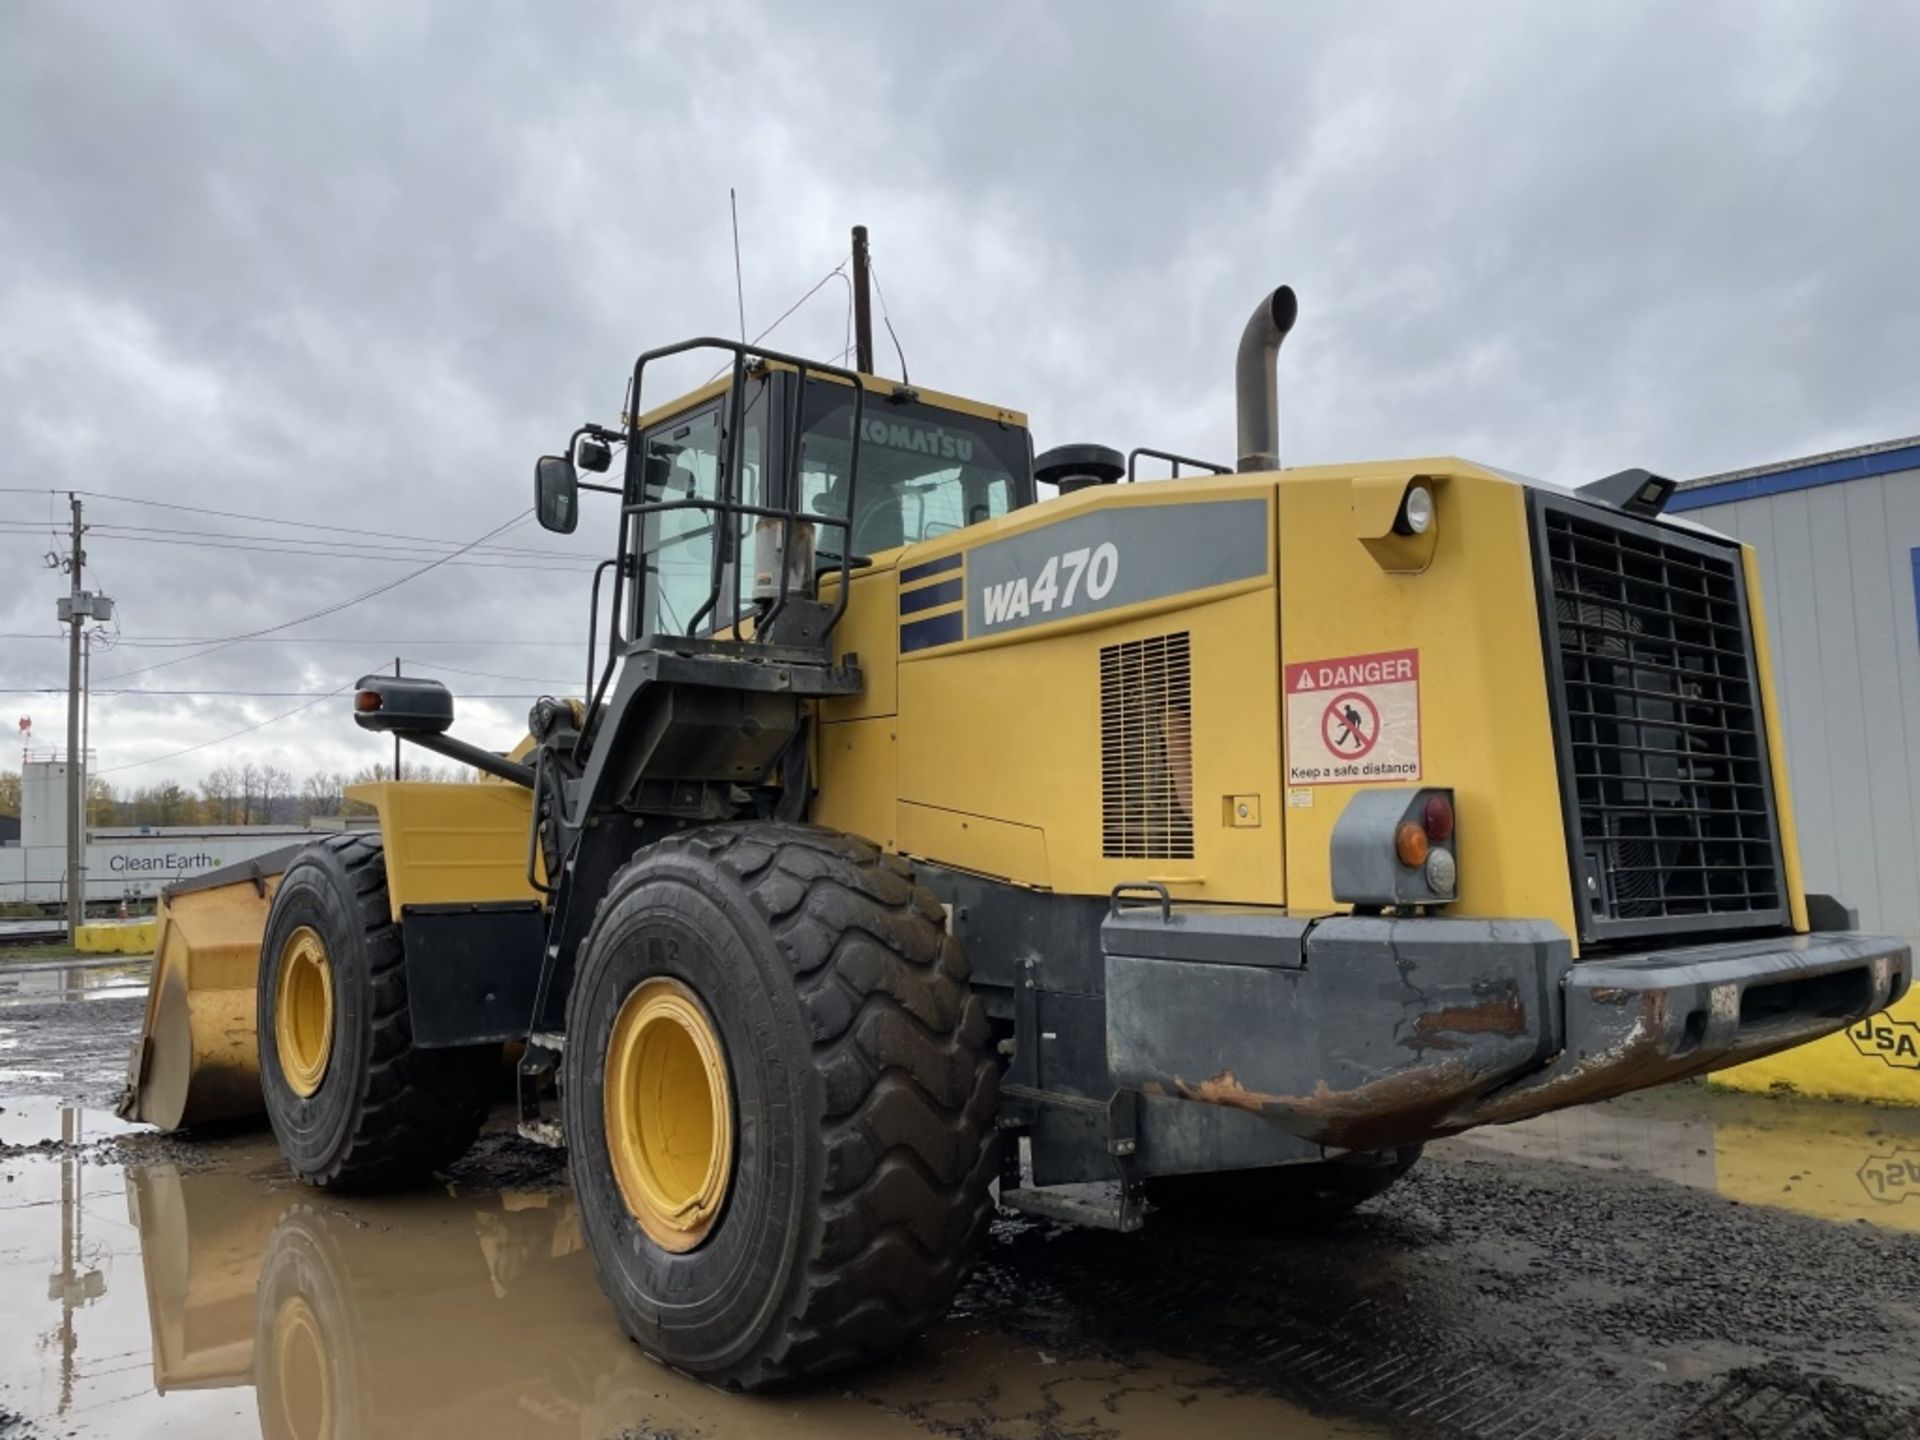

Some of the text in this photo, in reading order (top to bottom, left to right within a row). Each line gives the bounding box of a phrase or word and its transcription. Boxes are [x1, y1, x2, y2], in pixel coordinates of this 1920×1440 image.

[850, 416, 972, 461] KOMATSU
[983, 542, 1119, 625] WA470
[1319, 659, 1412, 688] DANGER
[1291, 762, 1417, 779] Keep a safe distance
[110, 853, 213, 871] CleanEarth
[1856, 1017, 1918, 1058] JSA
